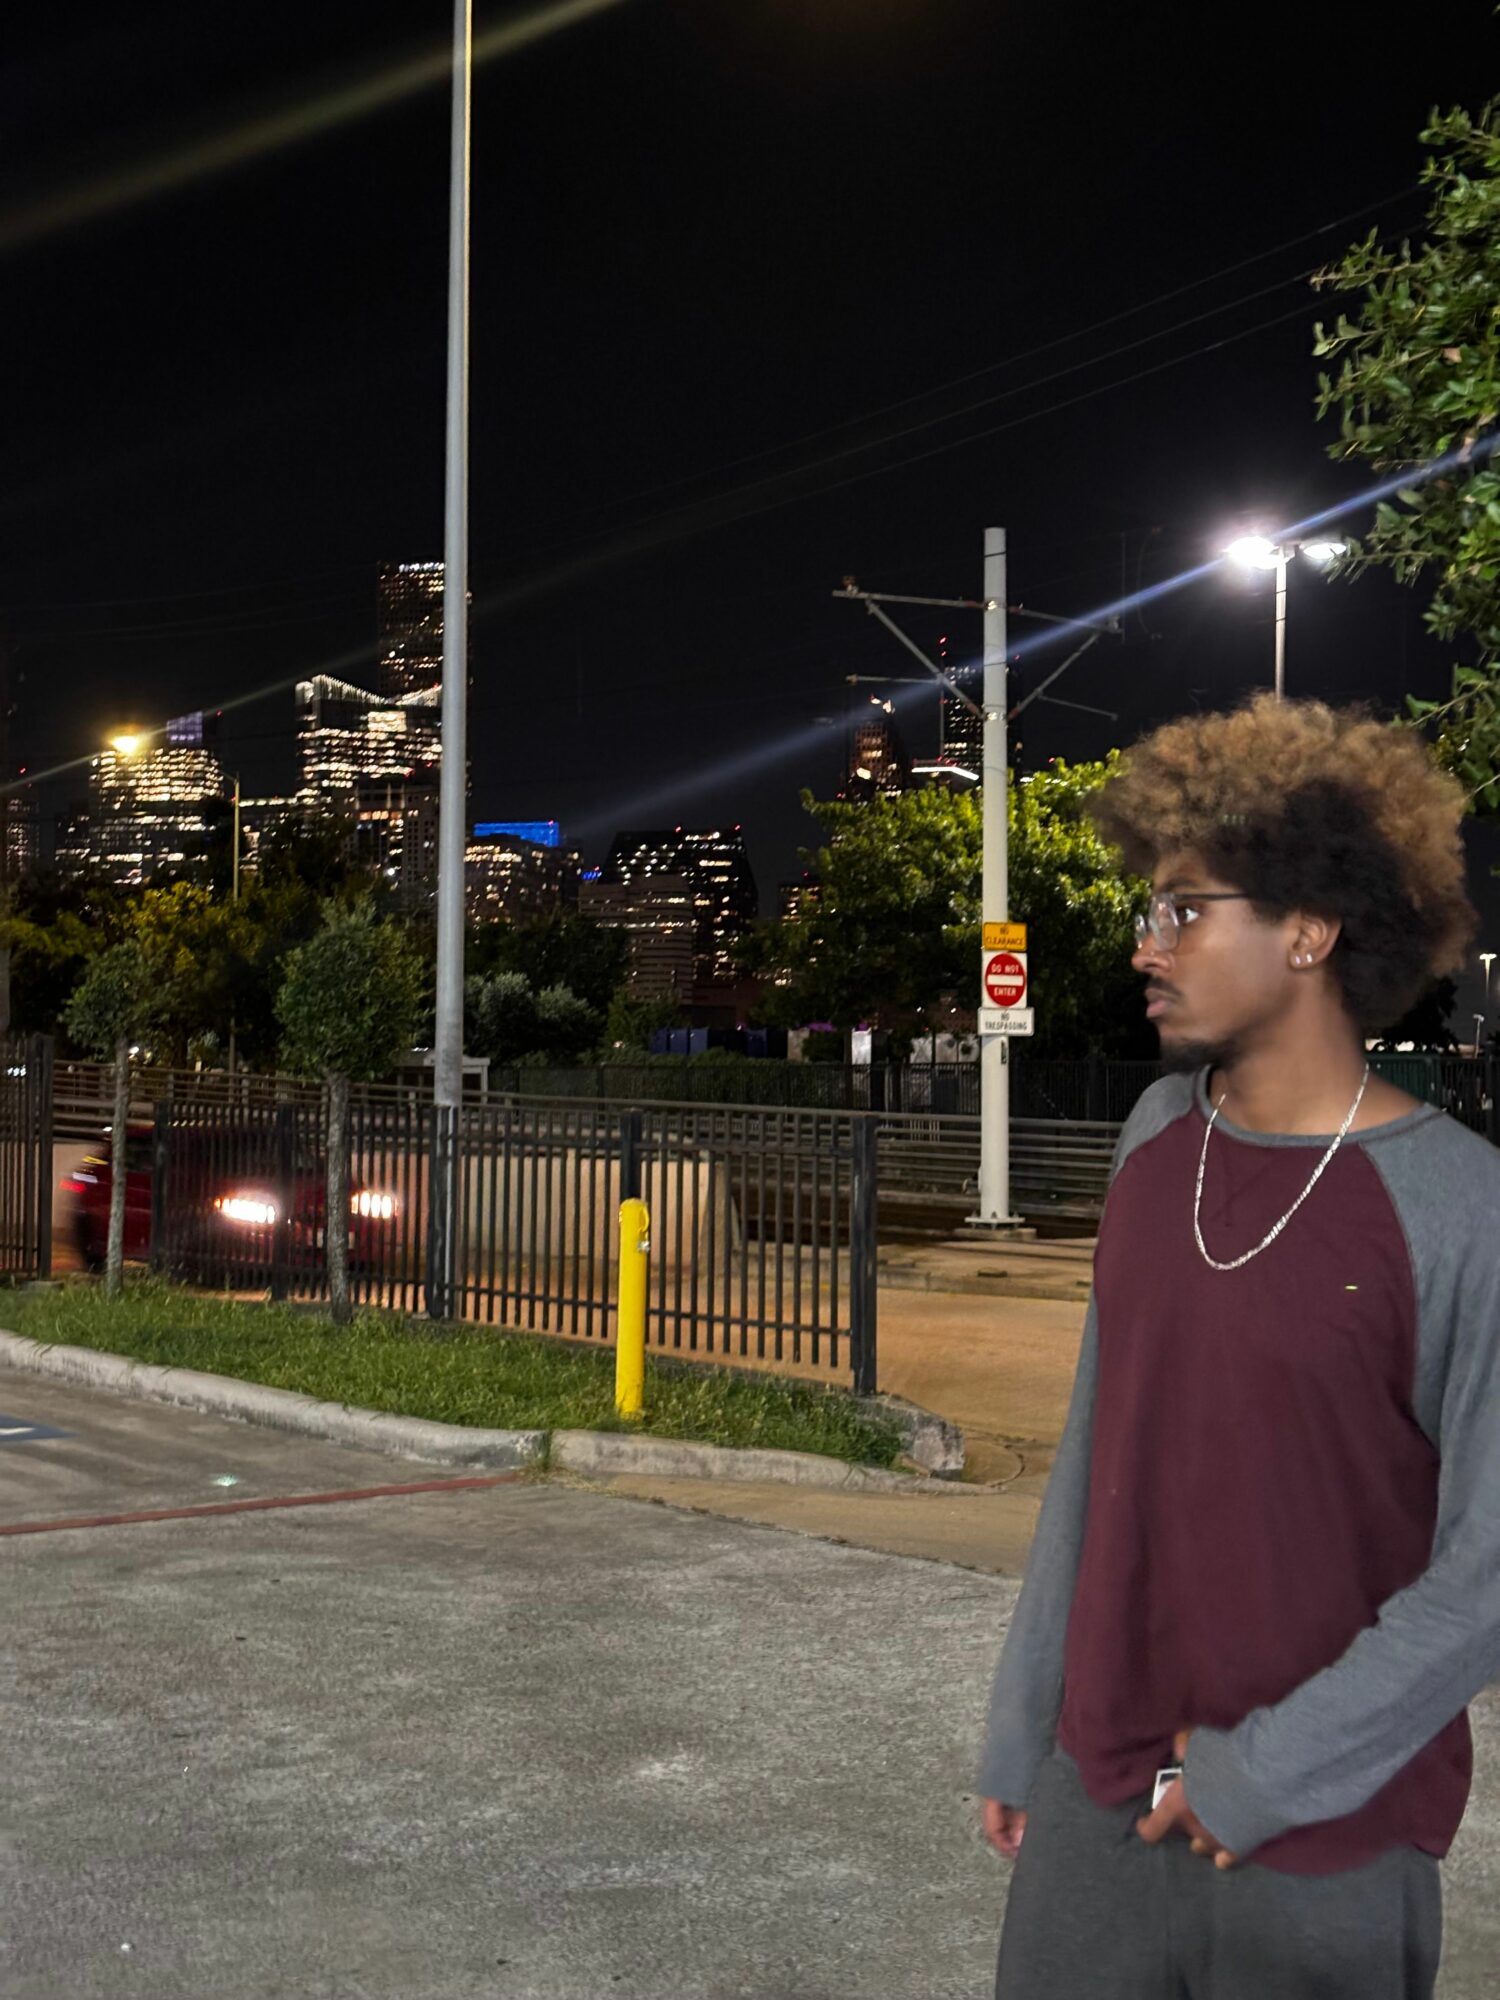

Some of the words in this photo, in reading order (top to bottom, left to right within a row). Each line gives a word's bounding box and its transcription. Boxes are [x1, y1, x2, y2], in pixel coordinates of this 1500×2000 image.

[986, 936, 1024, 945] CLEARANCE
[991, 963, 1002, 973] DO
[1004, 964, 1019, 974] NOT
[994, 987, 1017, 997] ENTER
[1001, 1012, 1010, 1021] NO
[985, 1021, 1028, 1030] TRESPASSING
